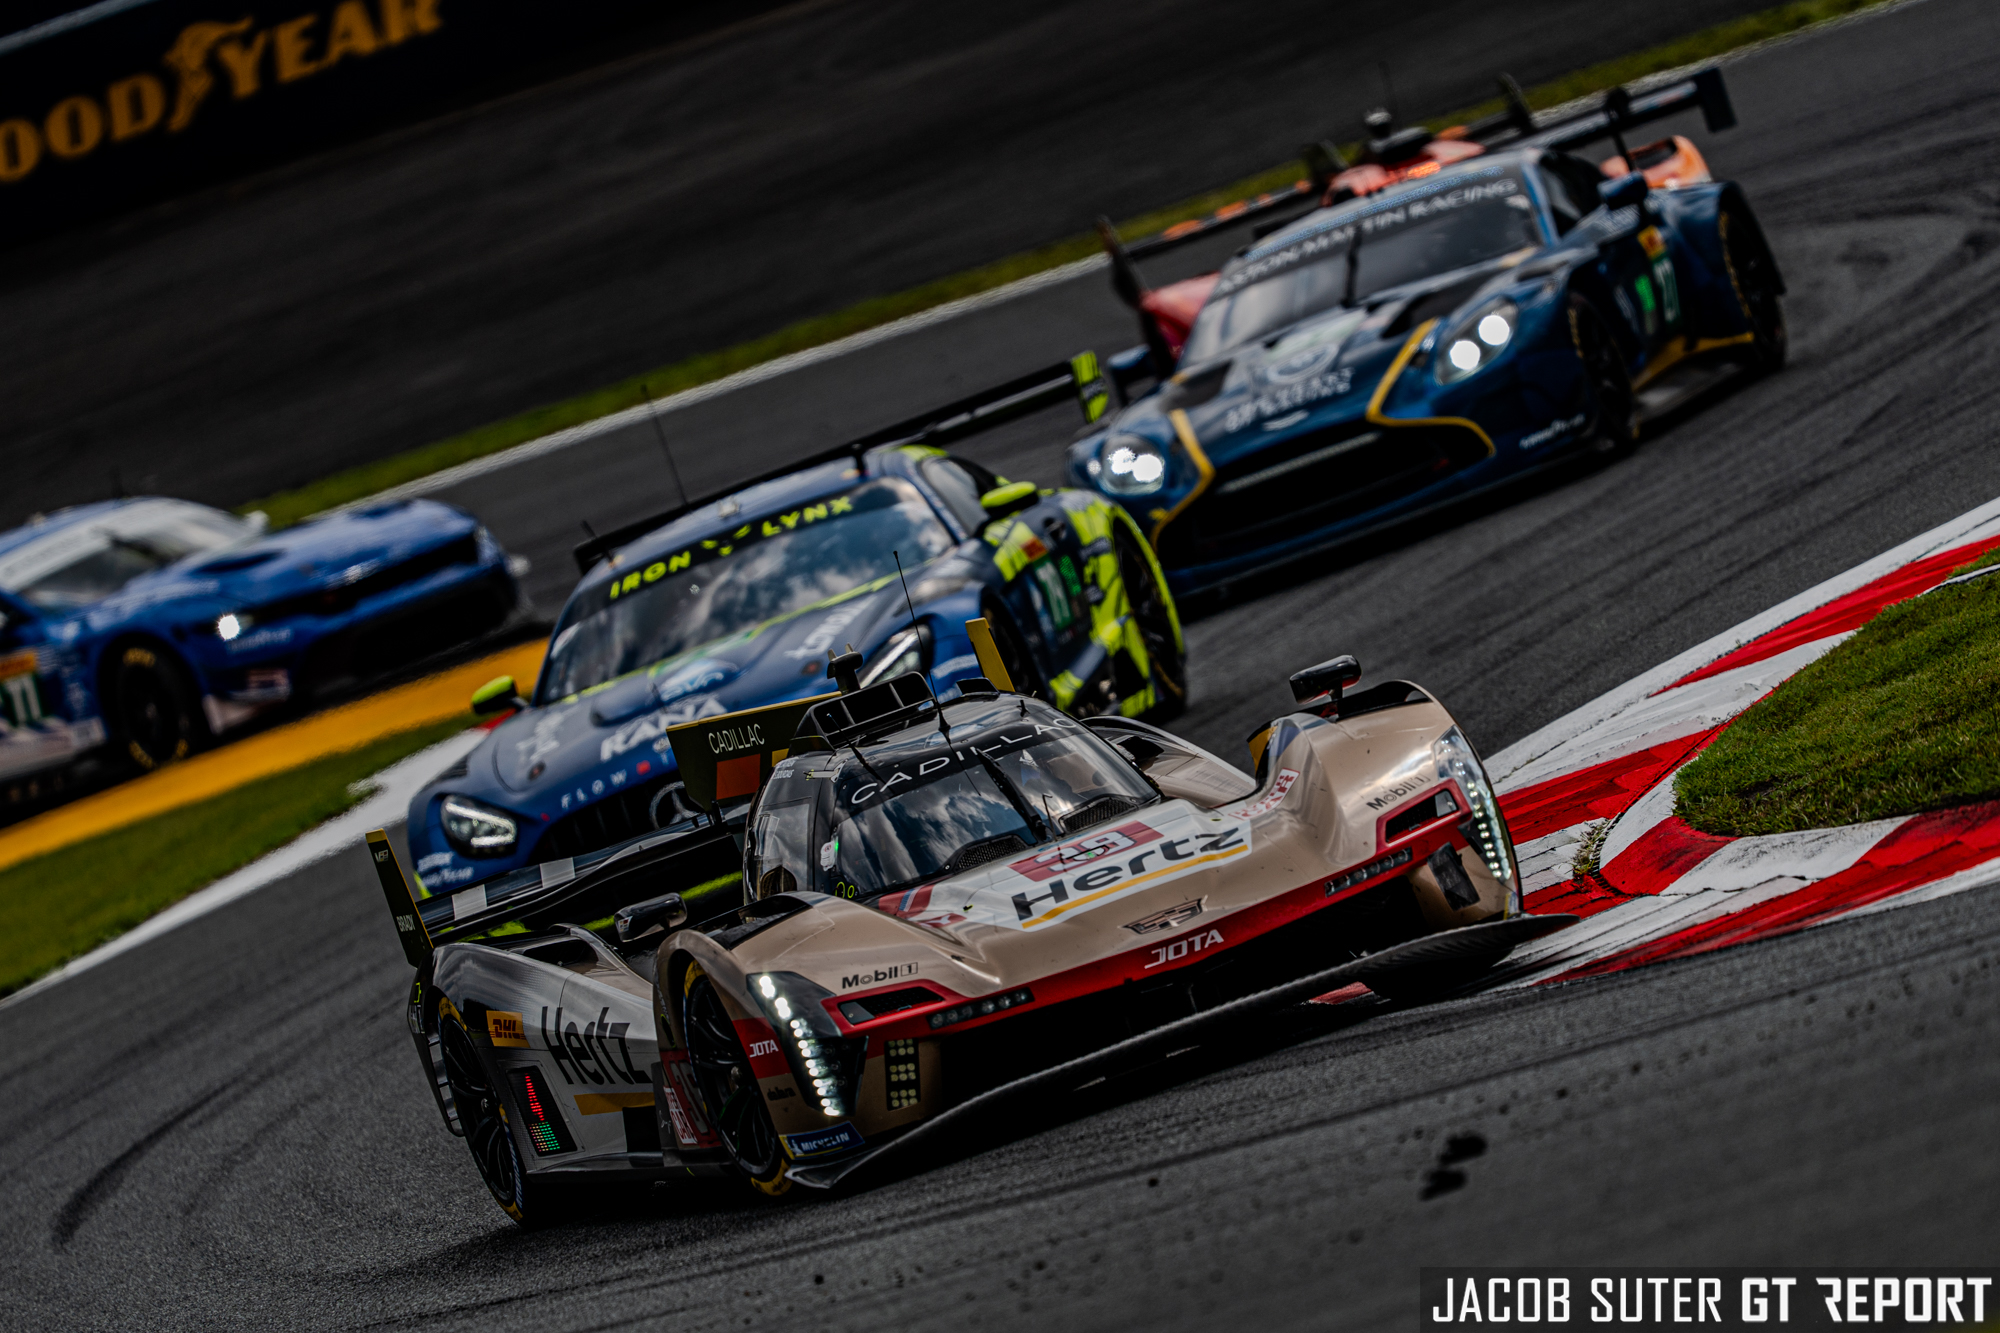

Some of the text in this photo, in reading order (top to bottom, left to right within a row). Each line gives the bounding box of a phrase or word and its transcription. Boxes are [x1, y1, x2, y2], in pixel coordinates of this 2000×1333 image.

[1408, 178, 1519, 217] RACING
[609, 496, 853, 600] IRON LYNX
[708, 723, 765, 754] CADILLAC
[851, 718, 1077, 804] CADILLAC
[1366, 780, 1416, 811] Mobil
[1012, 827, 1245, 921] Hertz
[1144, 929, 1224, 969] JOTA
[842, 966, 898, 989] Mobil
[492, 1018, 521, 1039] DHL
[541, 1006, 653, 1085] Hertz
[749, 1039, 779, 1058] JOTA
[801, 1131, 850, 1152] MICHELIN
